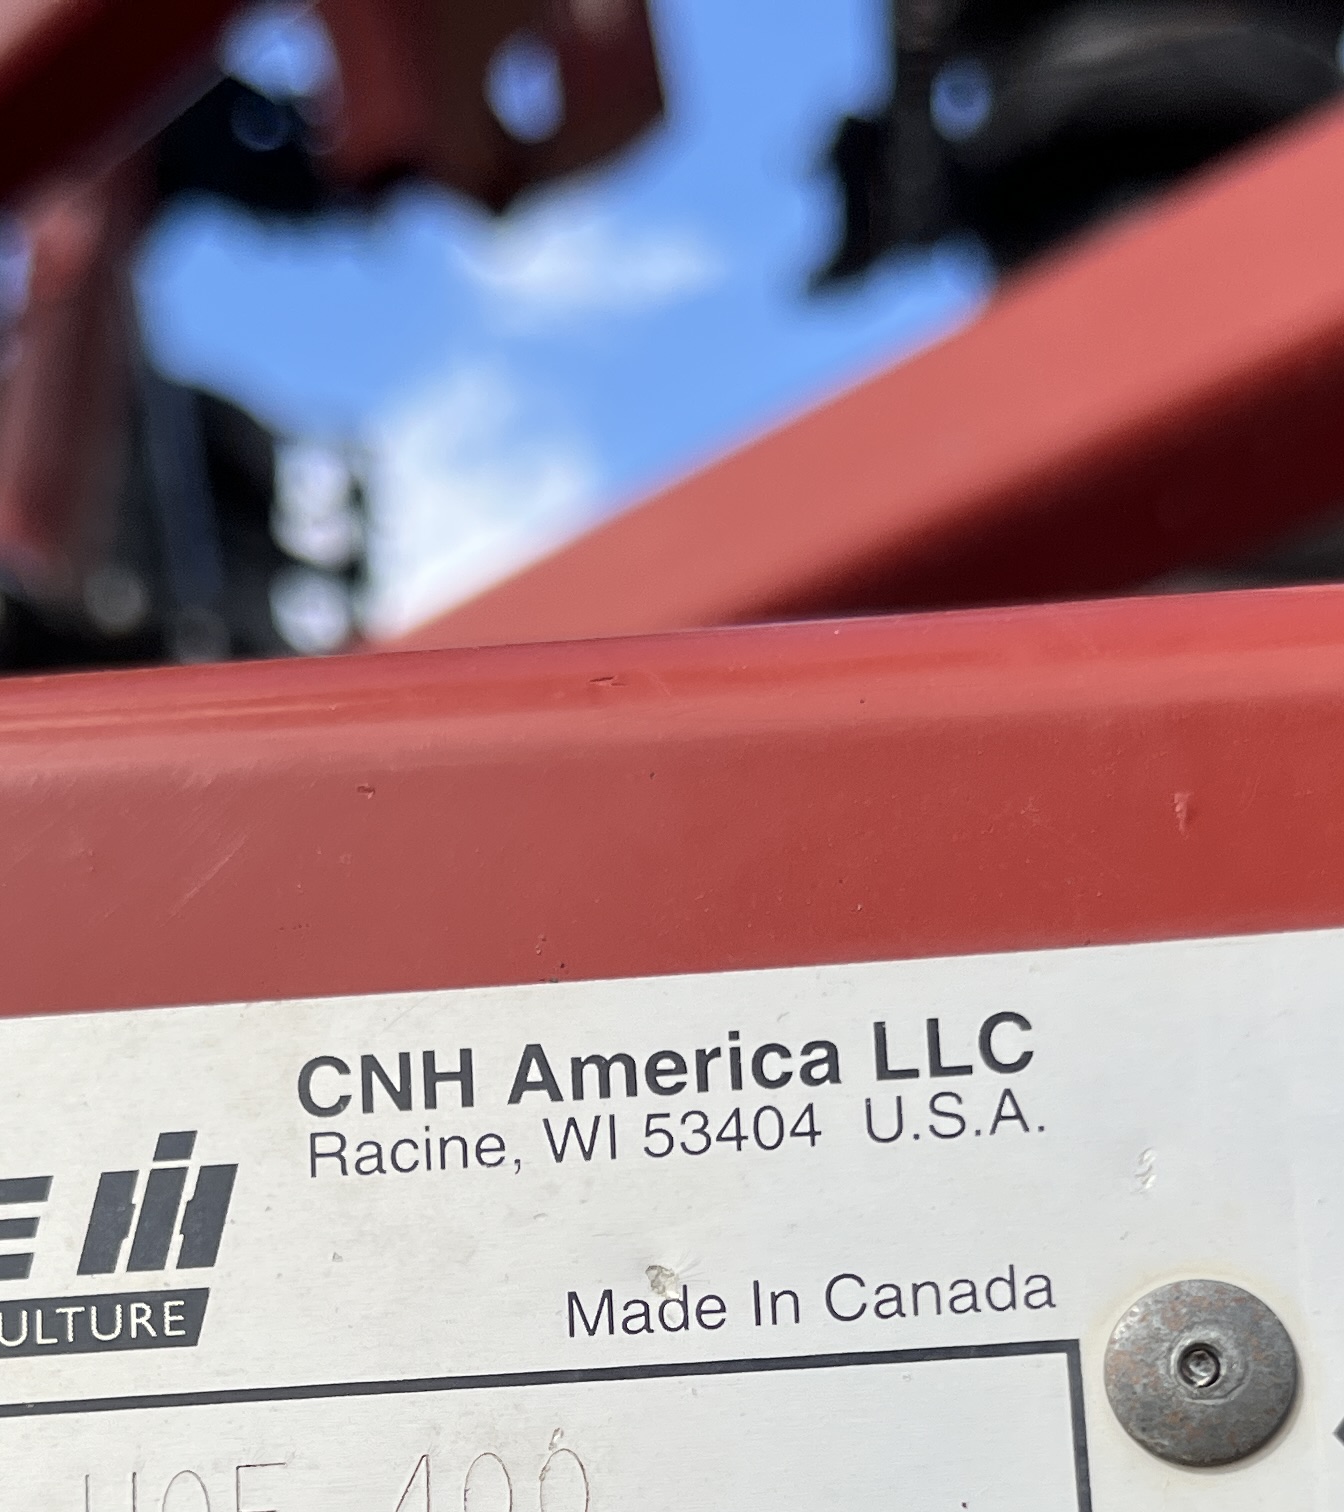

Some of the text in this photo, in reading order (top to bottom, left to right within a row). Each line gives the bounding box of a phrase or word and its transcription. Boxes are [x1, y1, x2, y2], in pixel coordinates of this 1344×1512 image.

[297, 1011, 1036, 1117] CNH America LLC
[309, 1087, 1047, 1178] Racine, WI 53404 U.S.A.
[567, 1264, 1058, 1338] Made In Canada
